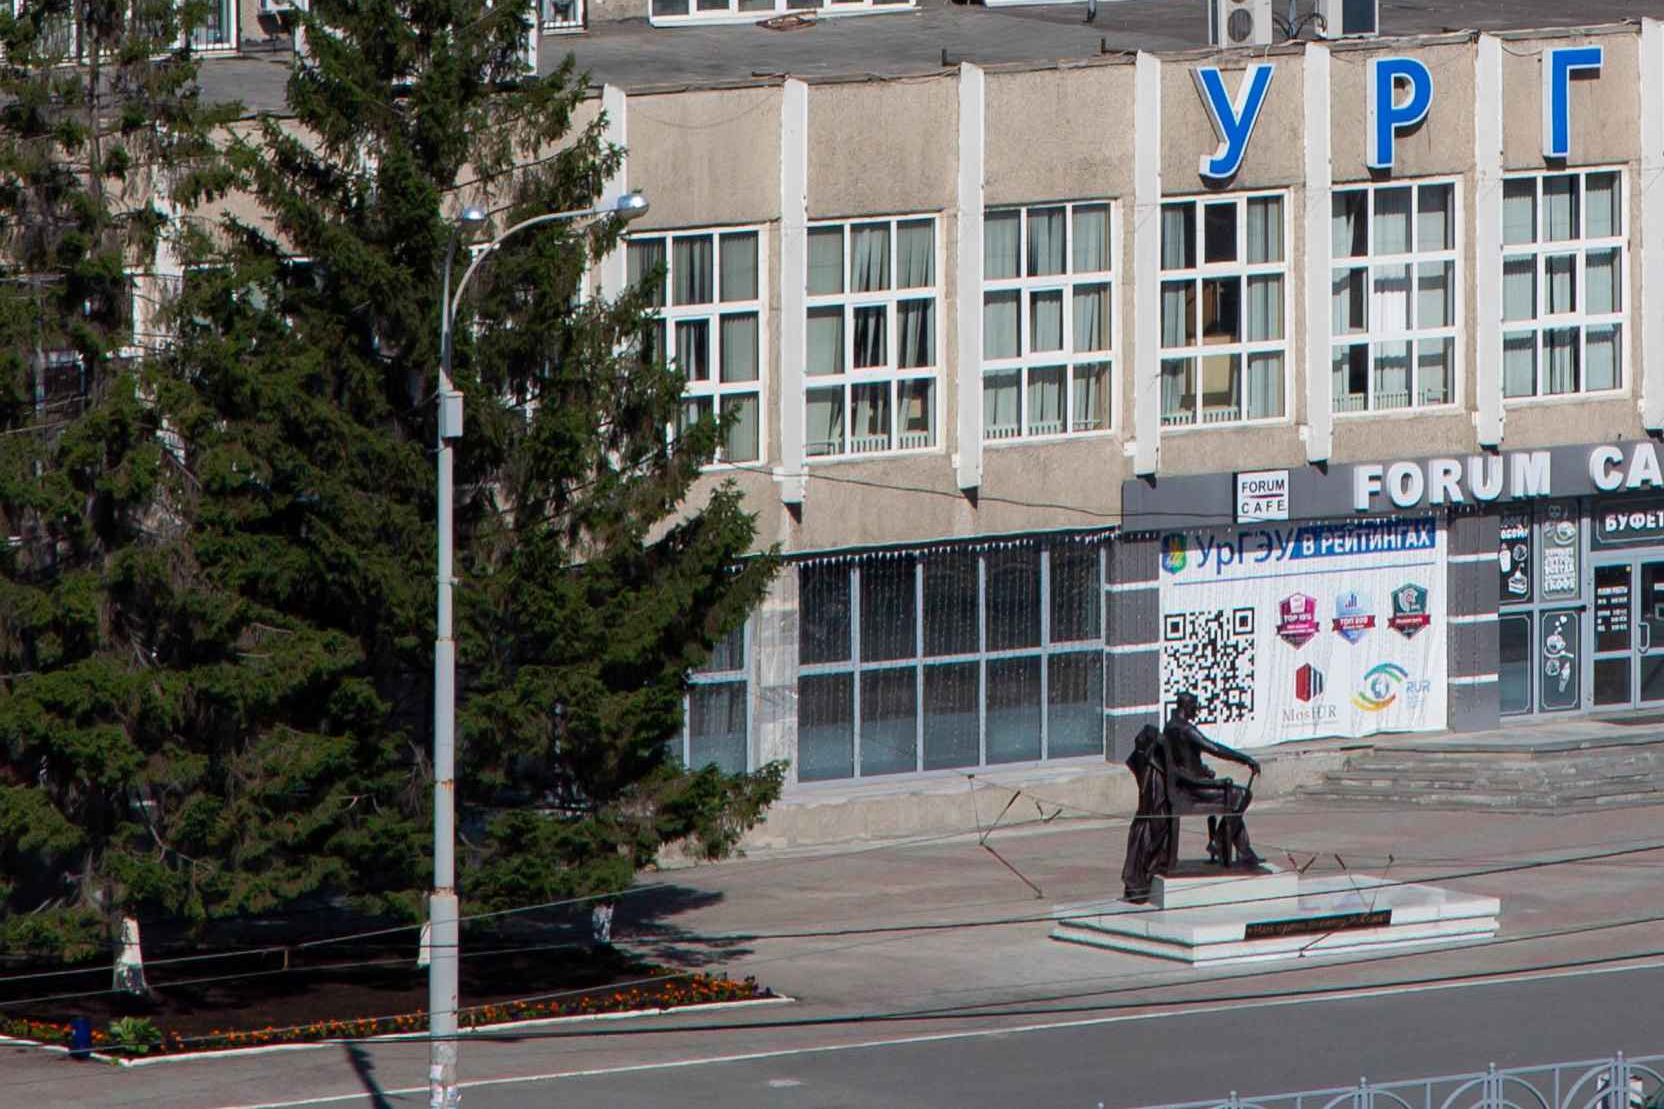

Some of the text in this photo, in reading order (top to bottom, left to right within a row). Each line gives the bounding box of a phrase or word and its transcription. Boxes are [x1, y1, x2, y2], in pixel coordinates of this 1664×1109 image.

[1241, 478, 1286, 494] FORUM
[1354, 452, 1551, 512] FORUM
[1241, 499, 1286, 515] CAFE
[1605, 510, 1664, 533] БУФЕТ
[1196, 527, 1432, 575] УрГЭУ В РЕЙТИНГАХ
